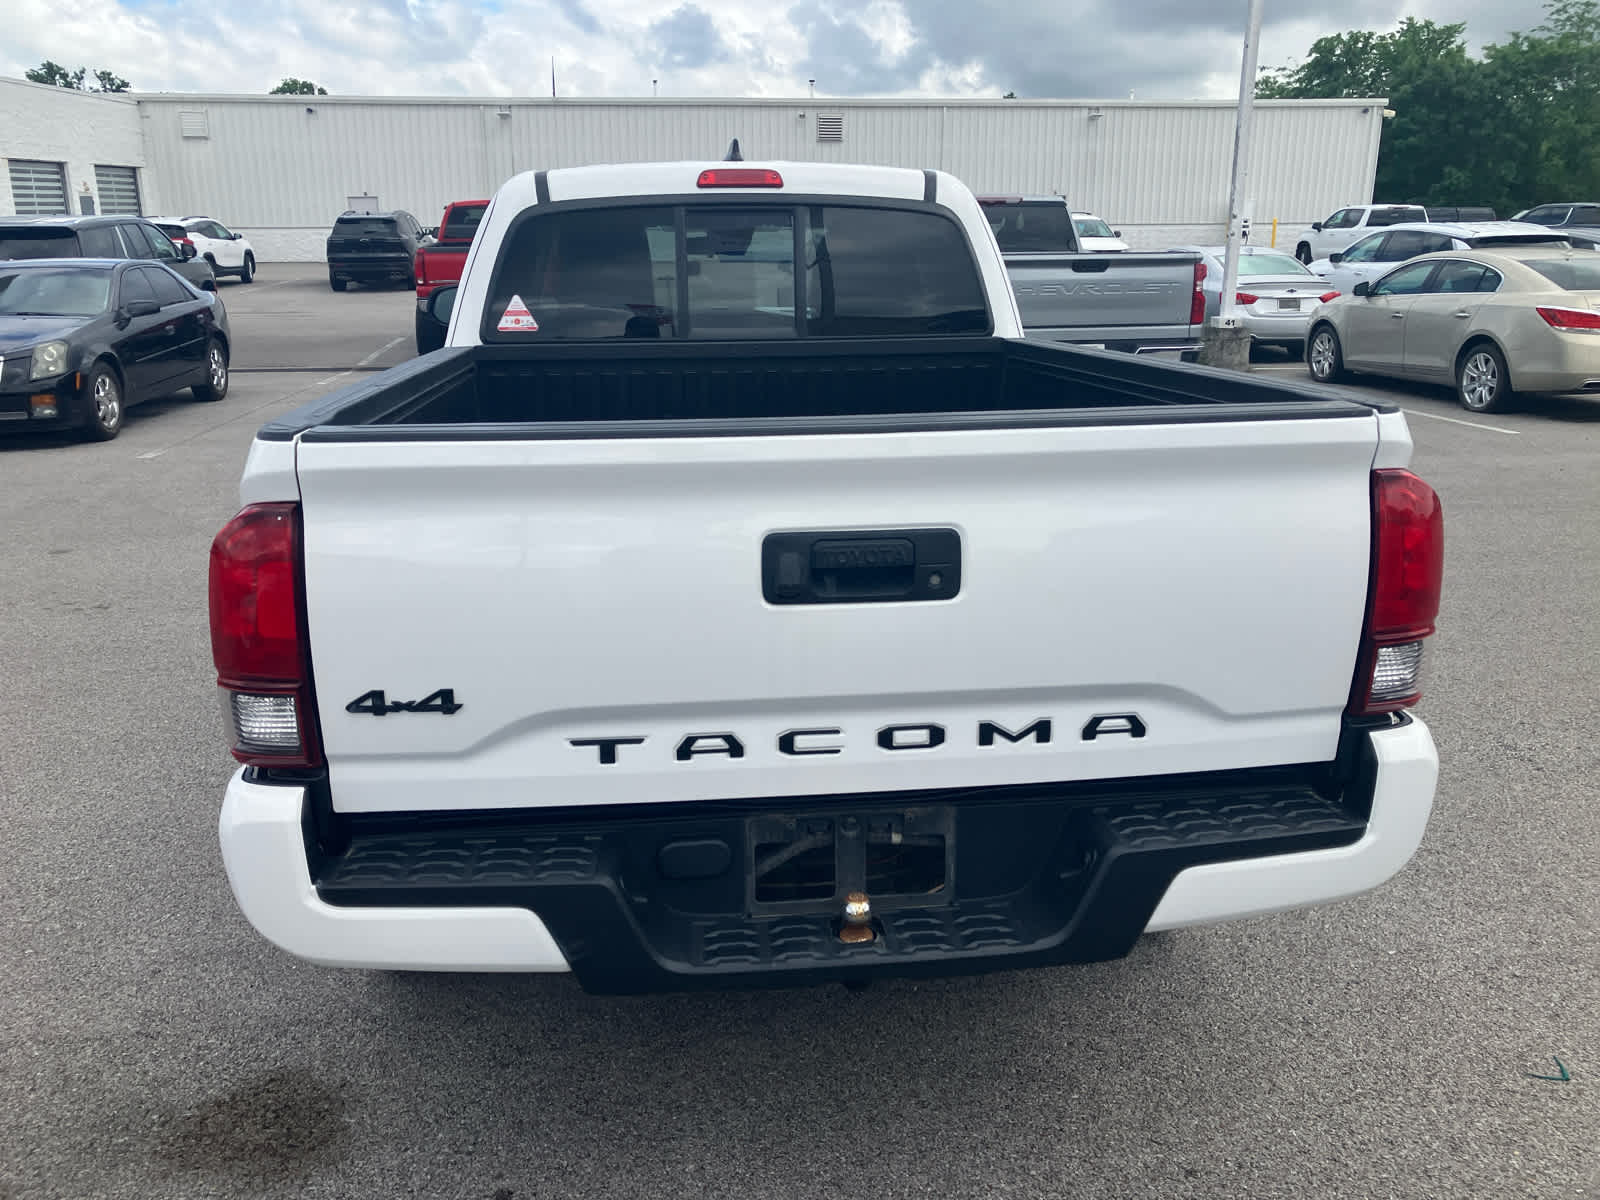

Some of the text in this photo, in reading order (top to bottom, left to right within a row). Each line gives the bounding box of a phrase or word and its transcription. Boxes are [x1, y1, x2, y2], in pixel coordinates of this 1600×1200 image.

[1015, 281, 1183, 296] HEVROLET
[823, 543, 909, 567] TOYOTA
[346, 688, 464, 716] 4x4
[568, 711, 1147, 764] TACOMA
